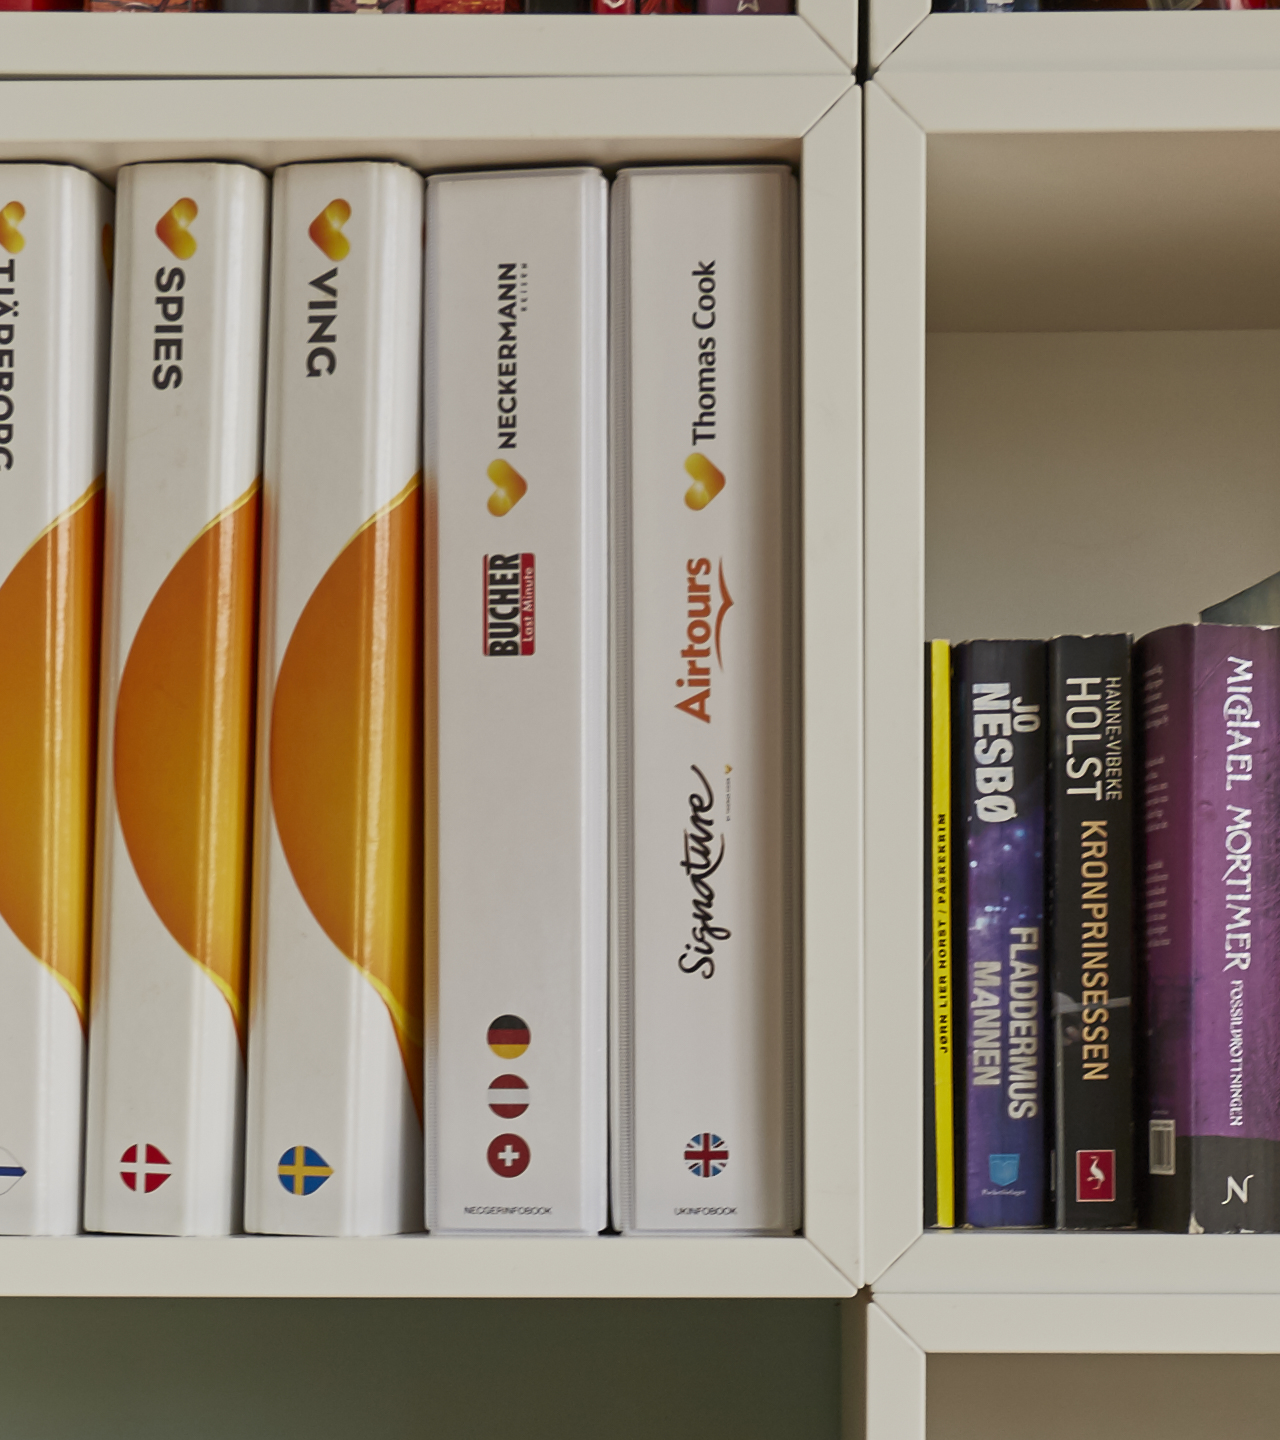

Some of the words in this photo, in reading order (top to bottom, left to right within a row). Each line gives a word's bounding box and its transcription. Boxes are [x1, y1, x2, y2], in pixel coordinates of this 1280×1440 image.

[152, 265, 186, 390] SPIES
[305, 267, 339, 379] VING
[498, 262, 517, 449] NECKERMANN
[691, 260, 716, 330] Cook
[691, 336, 716, 445] Thomas
[488, 554, 519, 656] BUCHER
[523, 567, 534, 613] Minute
[523, 615, 534, 643] Last
[674, 558, 711, 724] Airtours
[972, 683, 1017, 823] NESBØ
[1012, 697, 1040, 733] JO
[1066, 676, 1102, 801] HOLST
[1105, 677, 1122, 801] HANNE-VIBEKE
[679, 765, 732, 979] Signature
[1080, 821, 1109, 1081] KRONPRINSESSEN
[971, 961, 1000, 1086] MANNEN
[1008, 926, 1039, 1120] FLADDERMUS
